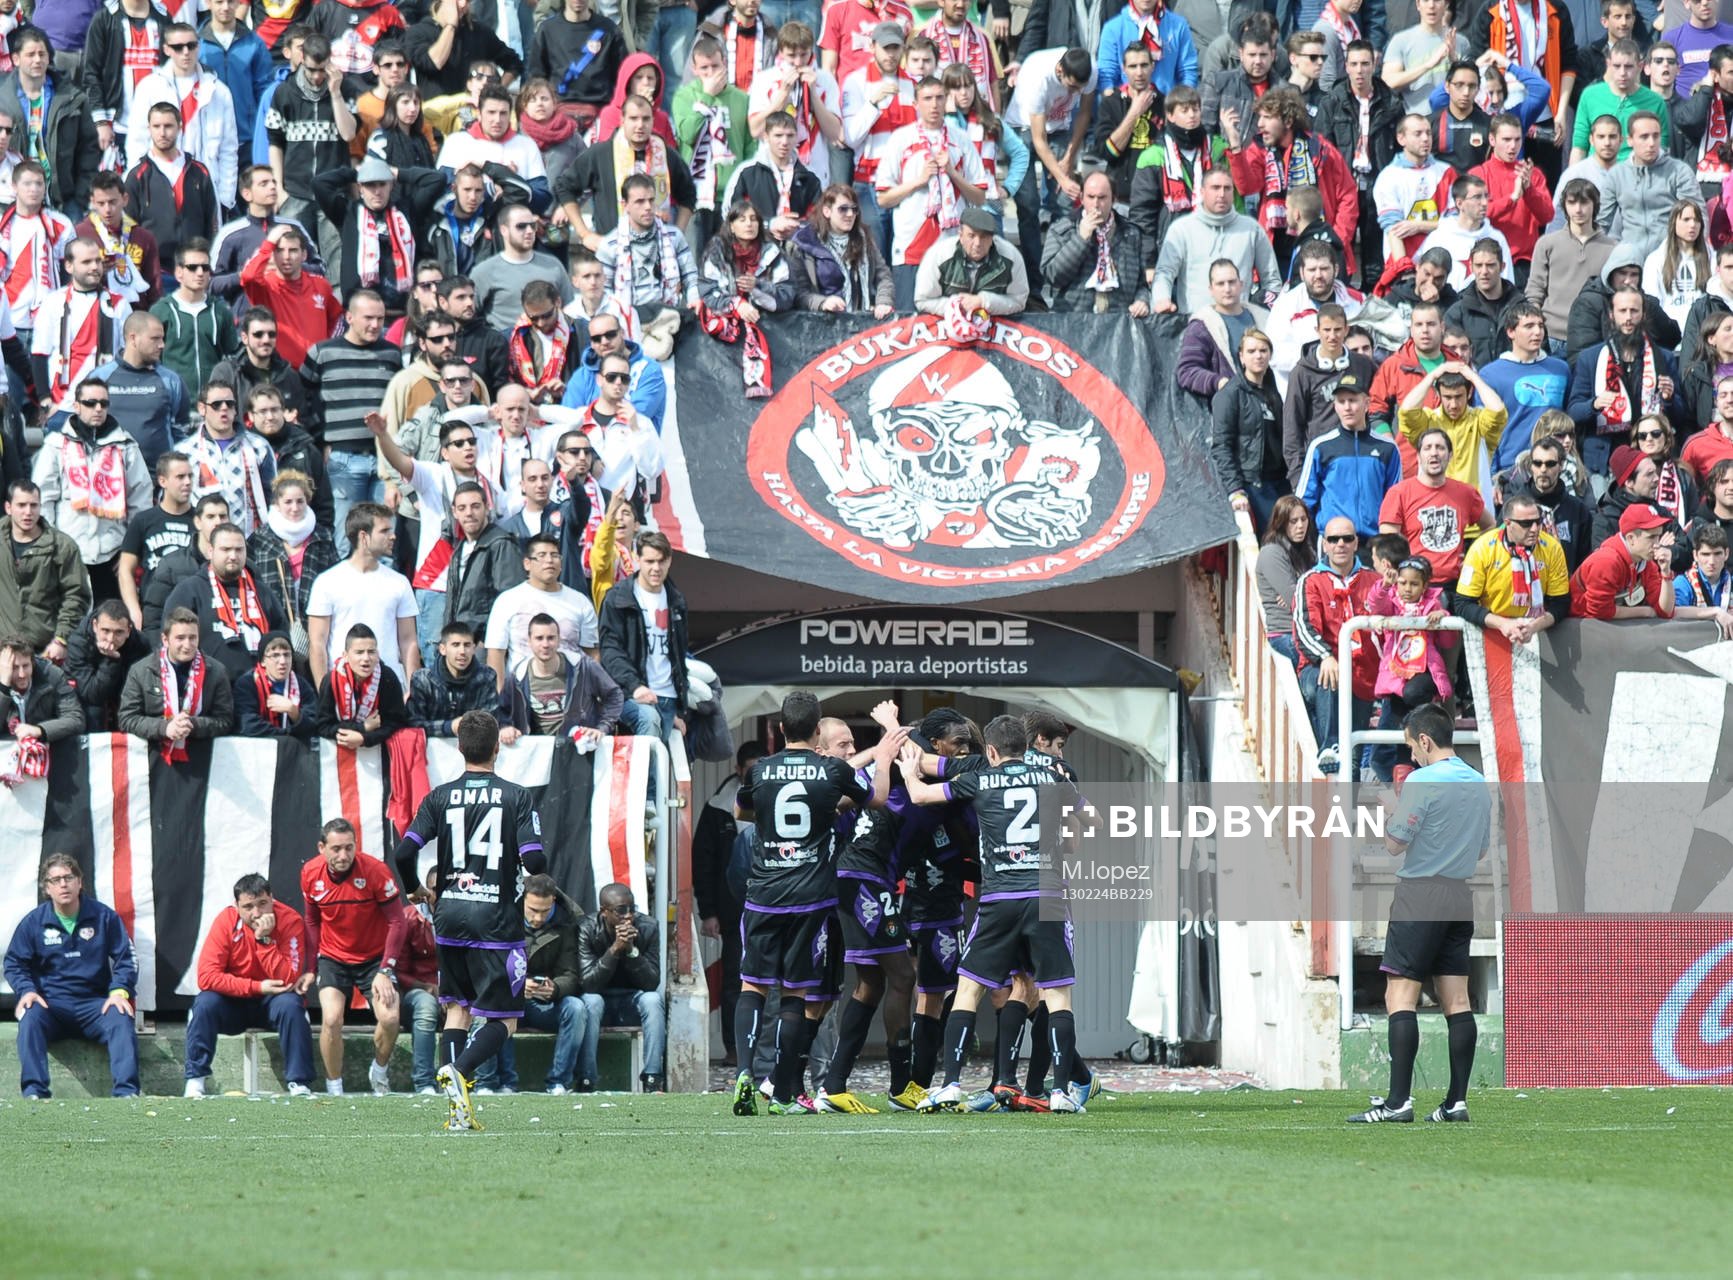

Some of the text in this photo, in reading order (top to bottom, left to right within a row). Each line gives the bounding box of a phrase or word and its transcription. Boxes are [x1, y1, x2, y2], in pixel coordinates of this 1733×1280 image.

[762, 472, 835, 538] HASTA
[844, 541, 885, 568] LA
[899, 556, 1067, 580] VICTORIA
[801, 619, 1029, 646] POWERADE
[801, 655, 1028, 679] bebida para deportistas
[761, 765, 828, 780] J.RUEDA
[979, 771, 1056, 791] RUKAVINA
[450, 788, 503, 805] OMAR
[774, 781, 812, 839] 6
[1003, 786, 1041, 845] 2
[446, 806, 504, 871] 14
